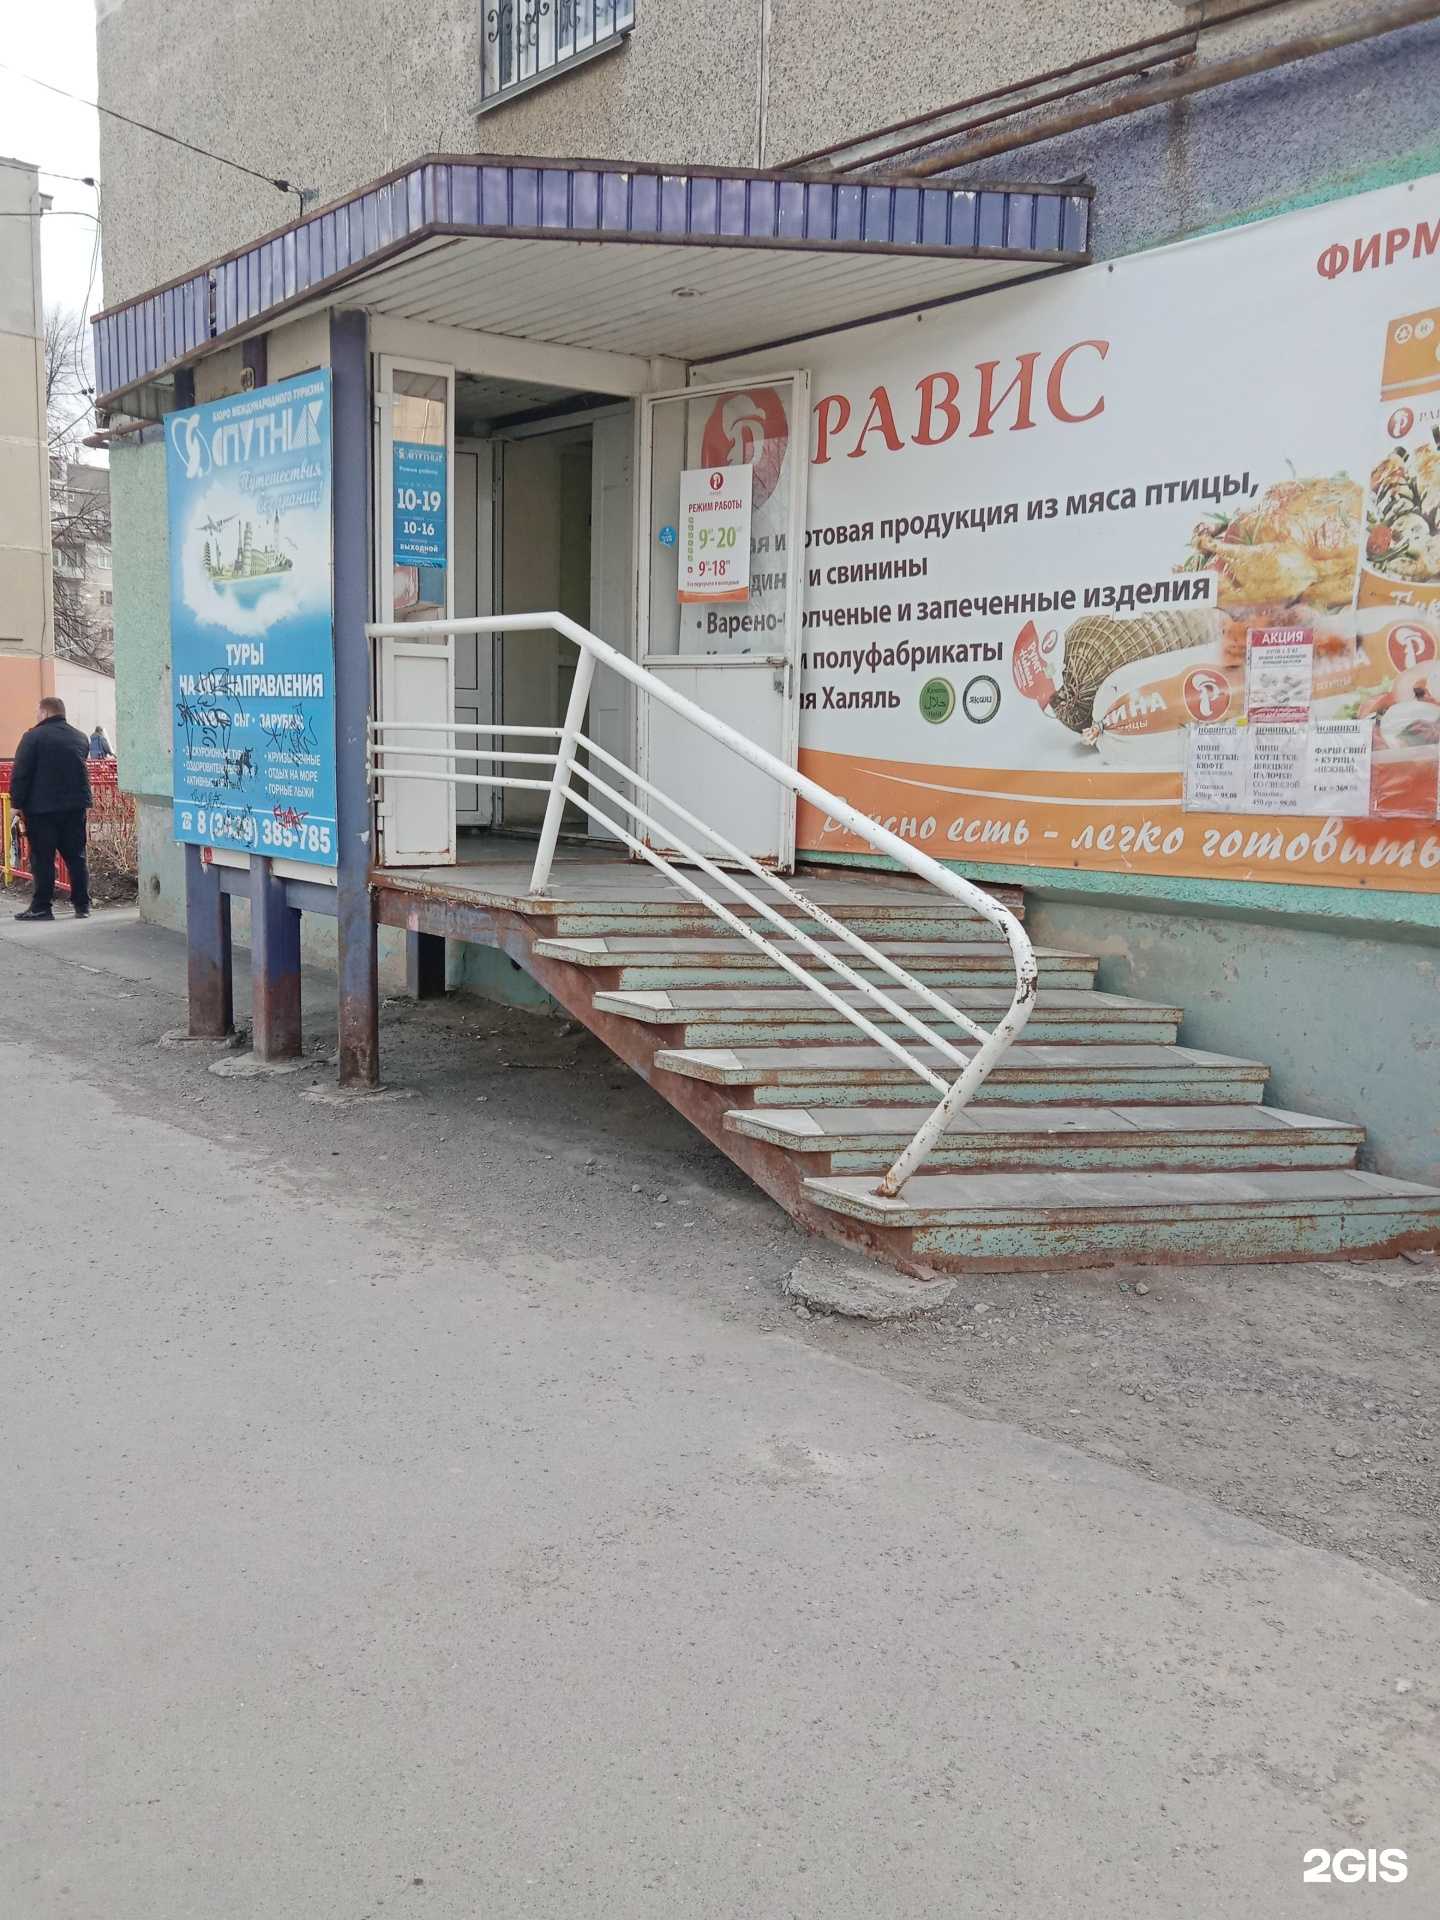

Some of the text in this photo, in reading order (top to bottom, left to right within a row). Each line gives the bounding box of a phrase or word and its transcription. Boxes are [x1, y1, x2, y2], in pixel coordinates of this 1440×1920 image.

[810, 340, 1110, 465] РАВИС
[397, 487, 442, 512] 10-19
[688, 500, 743, 513] РЕЖИМ РАБОТЫ
[804, 521, 874, 549] отовая
[880, 503, 1018, 544] продукция
[1027, 498, 1059, 521] из
[1066, 487, 1137, 517] мяса
[1145, 471, 1259, 508] птицы,
[403, 521, 435, 536] 10-16
[809, 568, 822, 587] и
[827, 557, 928, 585] свинины
[897, 602, 911, 622] и
[916, 588, 1077, 621] запеченные
[1083, 577, 1210, 612] изделия
[1262, 630, 1304, 645] АКЦИЯ
[225, 642, 264, 666] ТУРЫ
[813, 639, 1003, 674] полуфабрикаты
[227, 674, 324, 697] НАПРАВЛЕНИЯ
[822, 686, 901, 710] Халяль
[299, 771, 319, 783] МОРЕ
[268, 783, 314, 798] ГОРНЫЕ ЛЫЖИ
[197, 810, 207, 834] 8
[946, 816, 1030, 846] есть
[1071, 820, 1185, 855] легко
